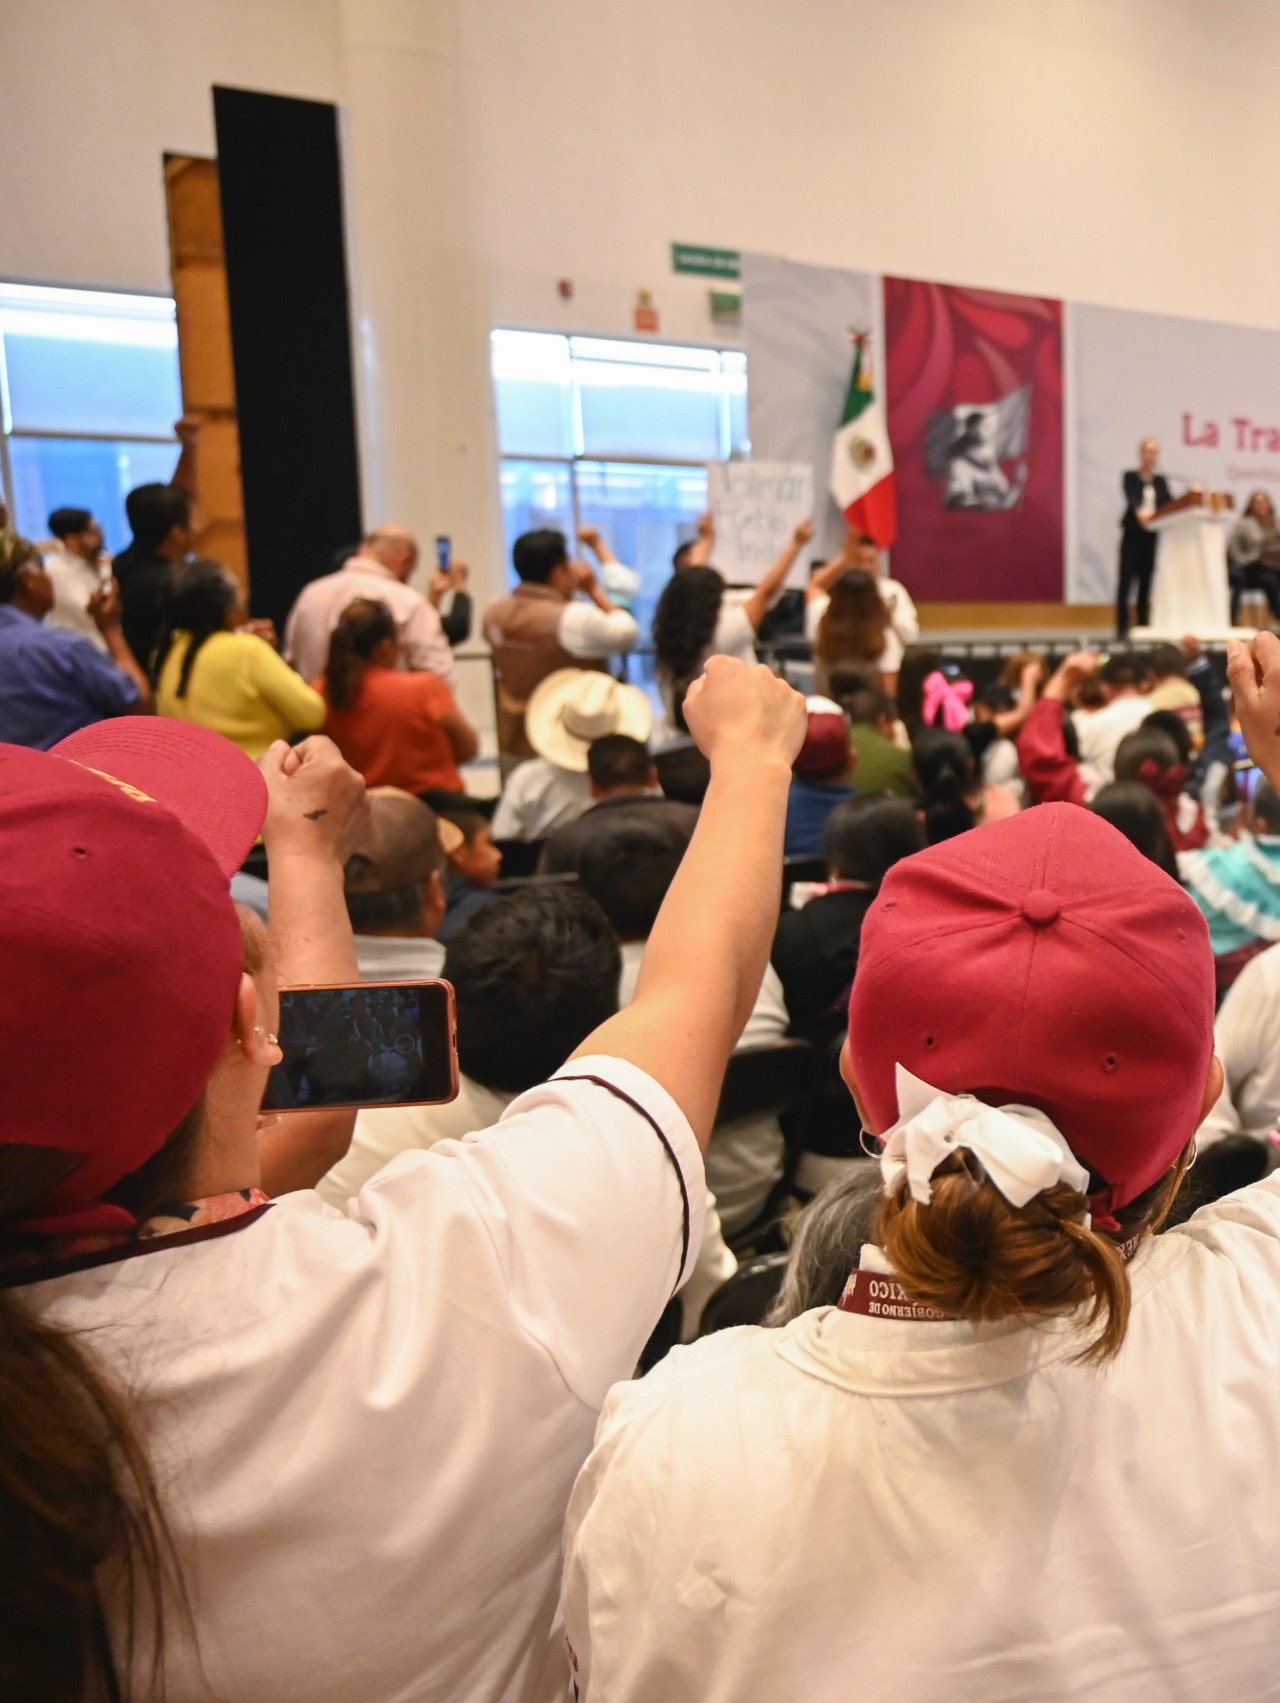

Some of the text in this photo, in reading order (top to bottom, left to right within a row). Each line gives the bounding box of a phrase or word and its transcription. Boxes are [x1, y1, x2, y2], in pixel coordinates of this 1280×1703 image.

[1181, 412, 1219, 449] La
[869, 1280, 909, 1301] XICO
[868, 1301, 945, 1319] GOBIERNO DE
